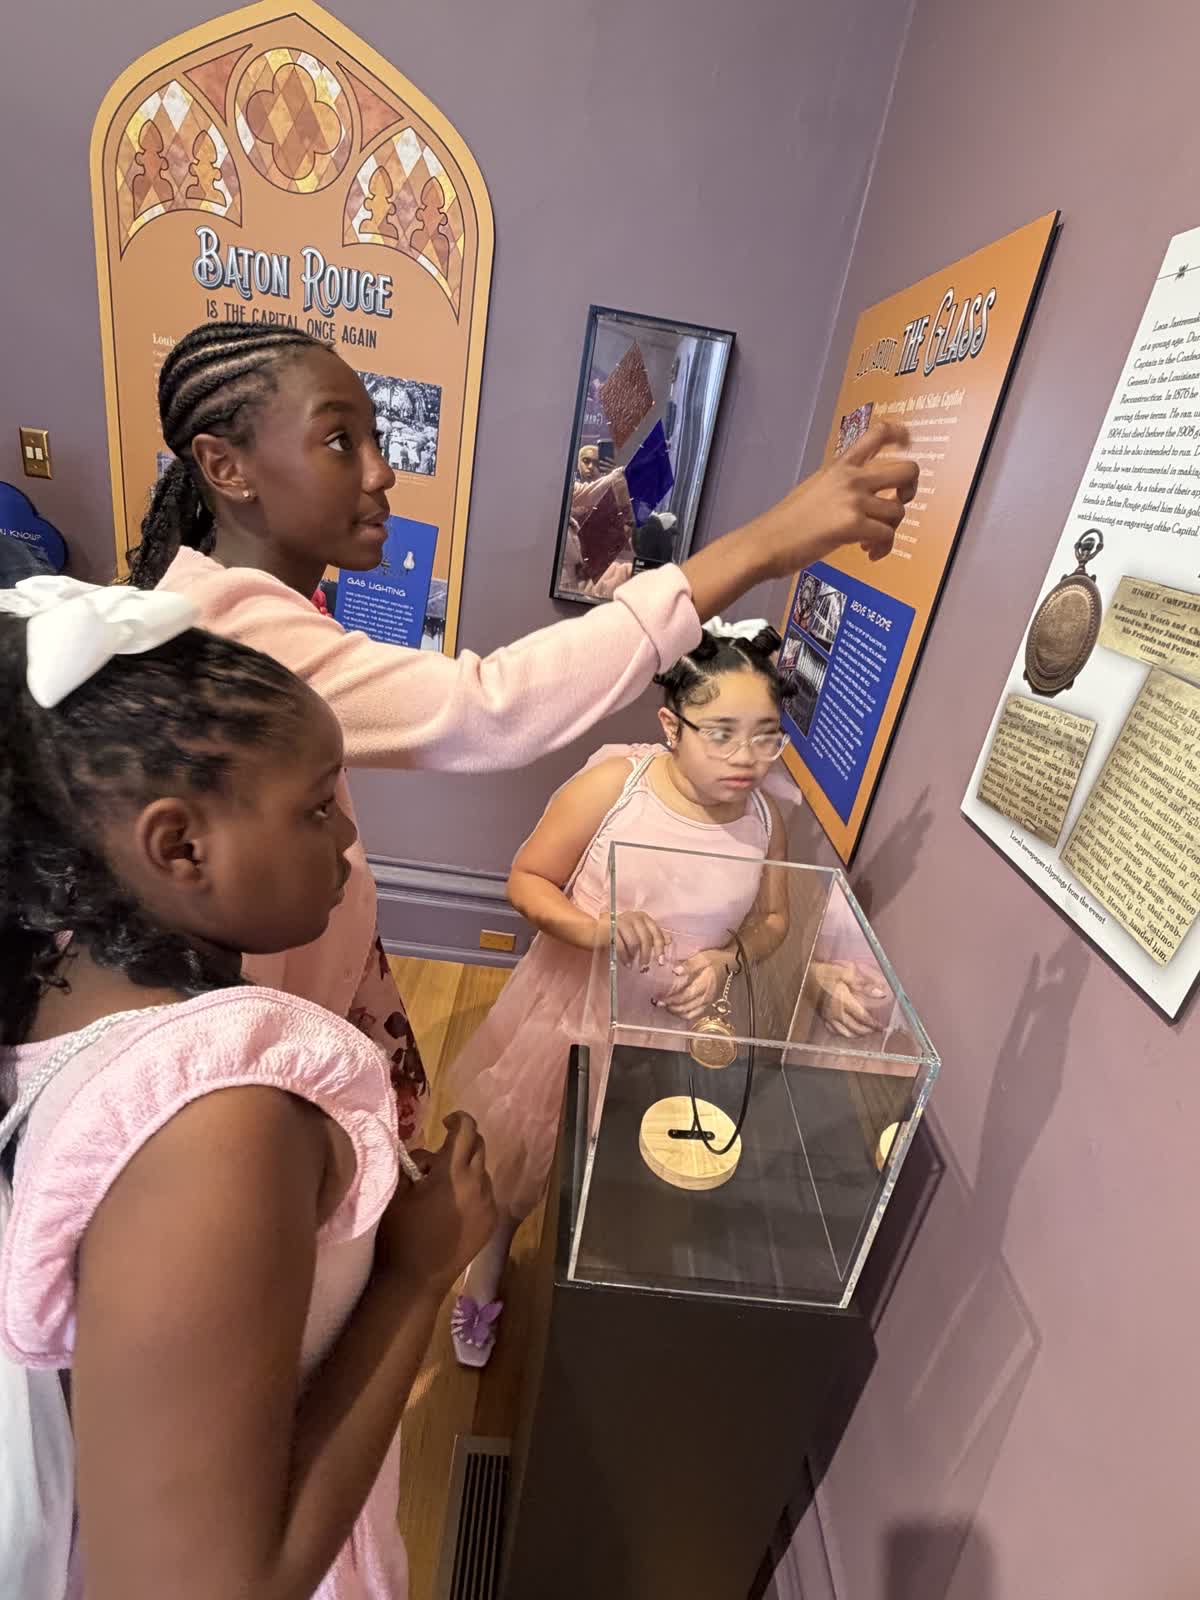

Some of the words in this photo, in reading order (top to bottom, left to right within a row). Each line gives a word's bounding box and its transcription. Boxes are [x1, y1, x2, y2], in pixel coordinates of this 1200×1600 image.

[193, 225, 290, 300] BATON
[300, 246, 393, 318] ROUGE
[206, 299, 219, 319] IS
[224, 302, 246, 323] THE
[306, 319, 336, 341] ONCE
[341, 325, 377, 349] AGAIN
[895, 314, 930, 377] THE
[923, 286, 996, 377] GLASS
[346, 577, 366, 588] GAS
[368, 581, 406, 597] LIGHTING
[866, 608, 877, 622] THE
[1010, 829, 1024, 847] Local
[1045, 865, 1067, 889] clippings
[1067, 883, 1080, 900] from
[1079, 896, 1089, 908] the
[1089, 907, 1106, 924] event
